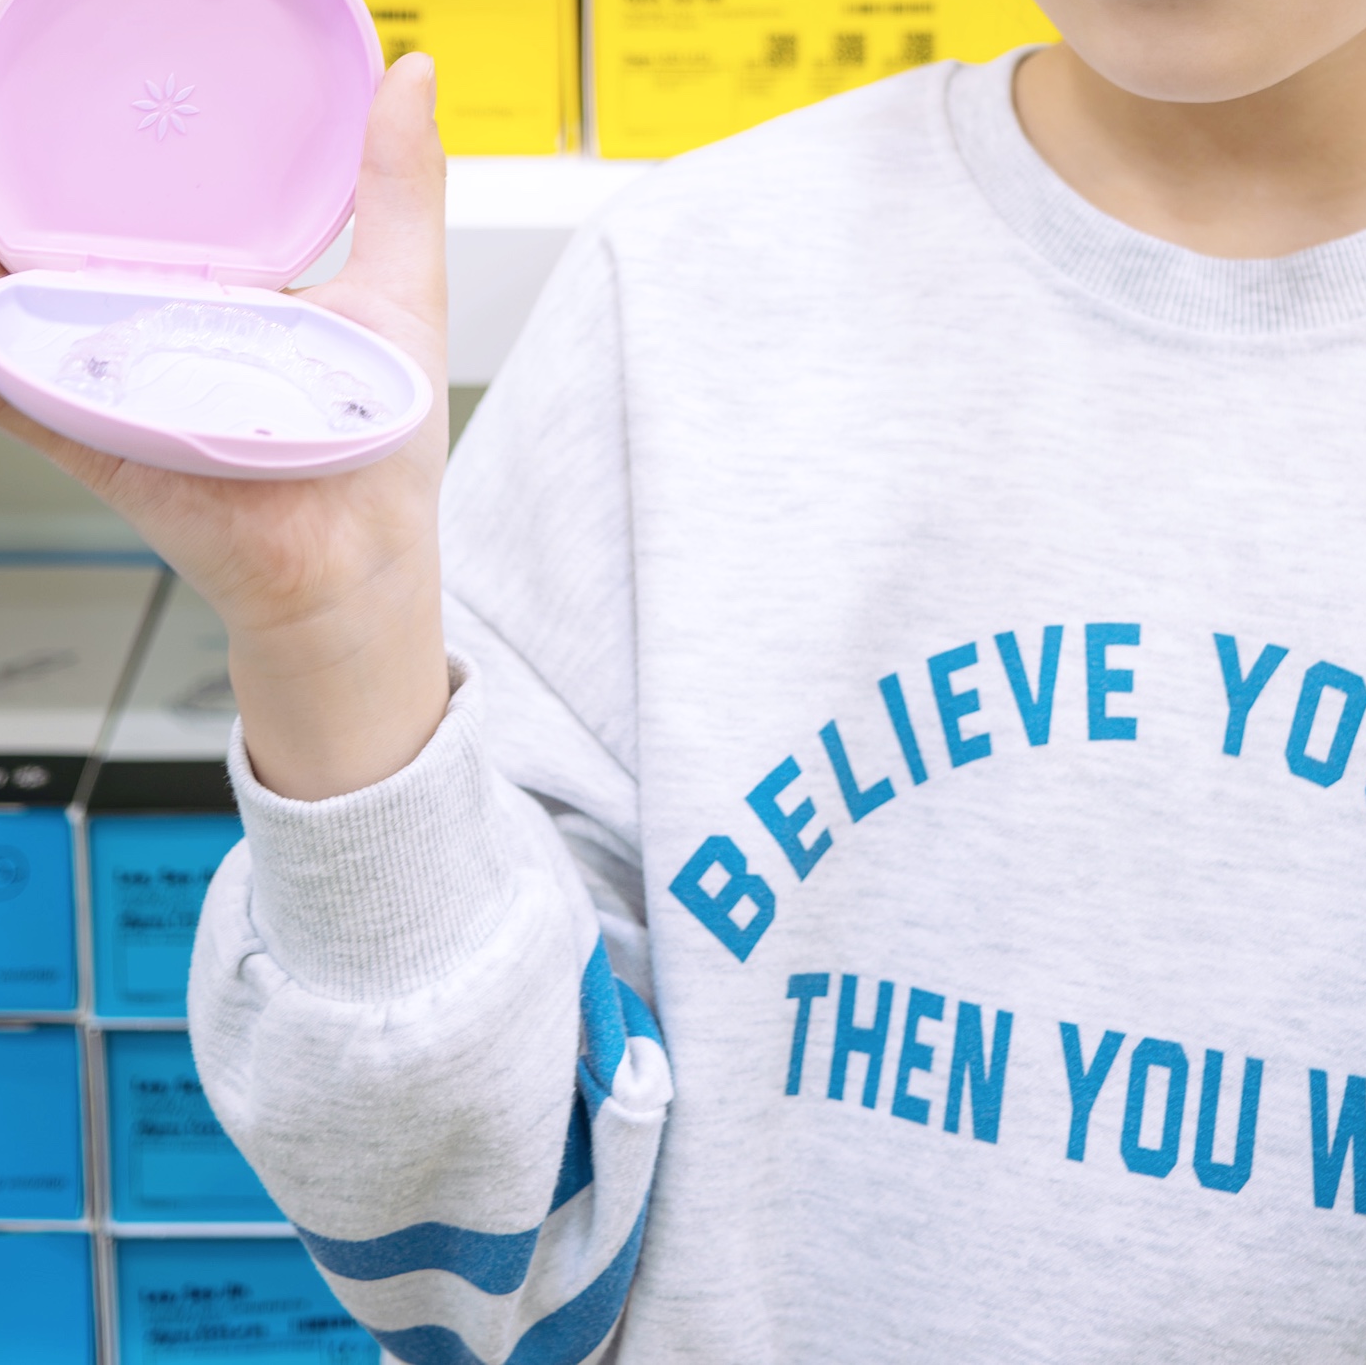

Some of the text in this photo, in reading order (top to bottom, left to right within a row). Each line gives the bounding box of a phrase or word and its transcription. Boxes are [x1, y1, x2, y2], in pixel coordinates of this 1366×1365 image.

[668, 622, 1142, 963] BELIEVE
[784, 971, 1014, 1145] THEN
[1058, 1020, 1264, 1194] YOU
